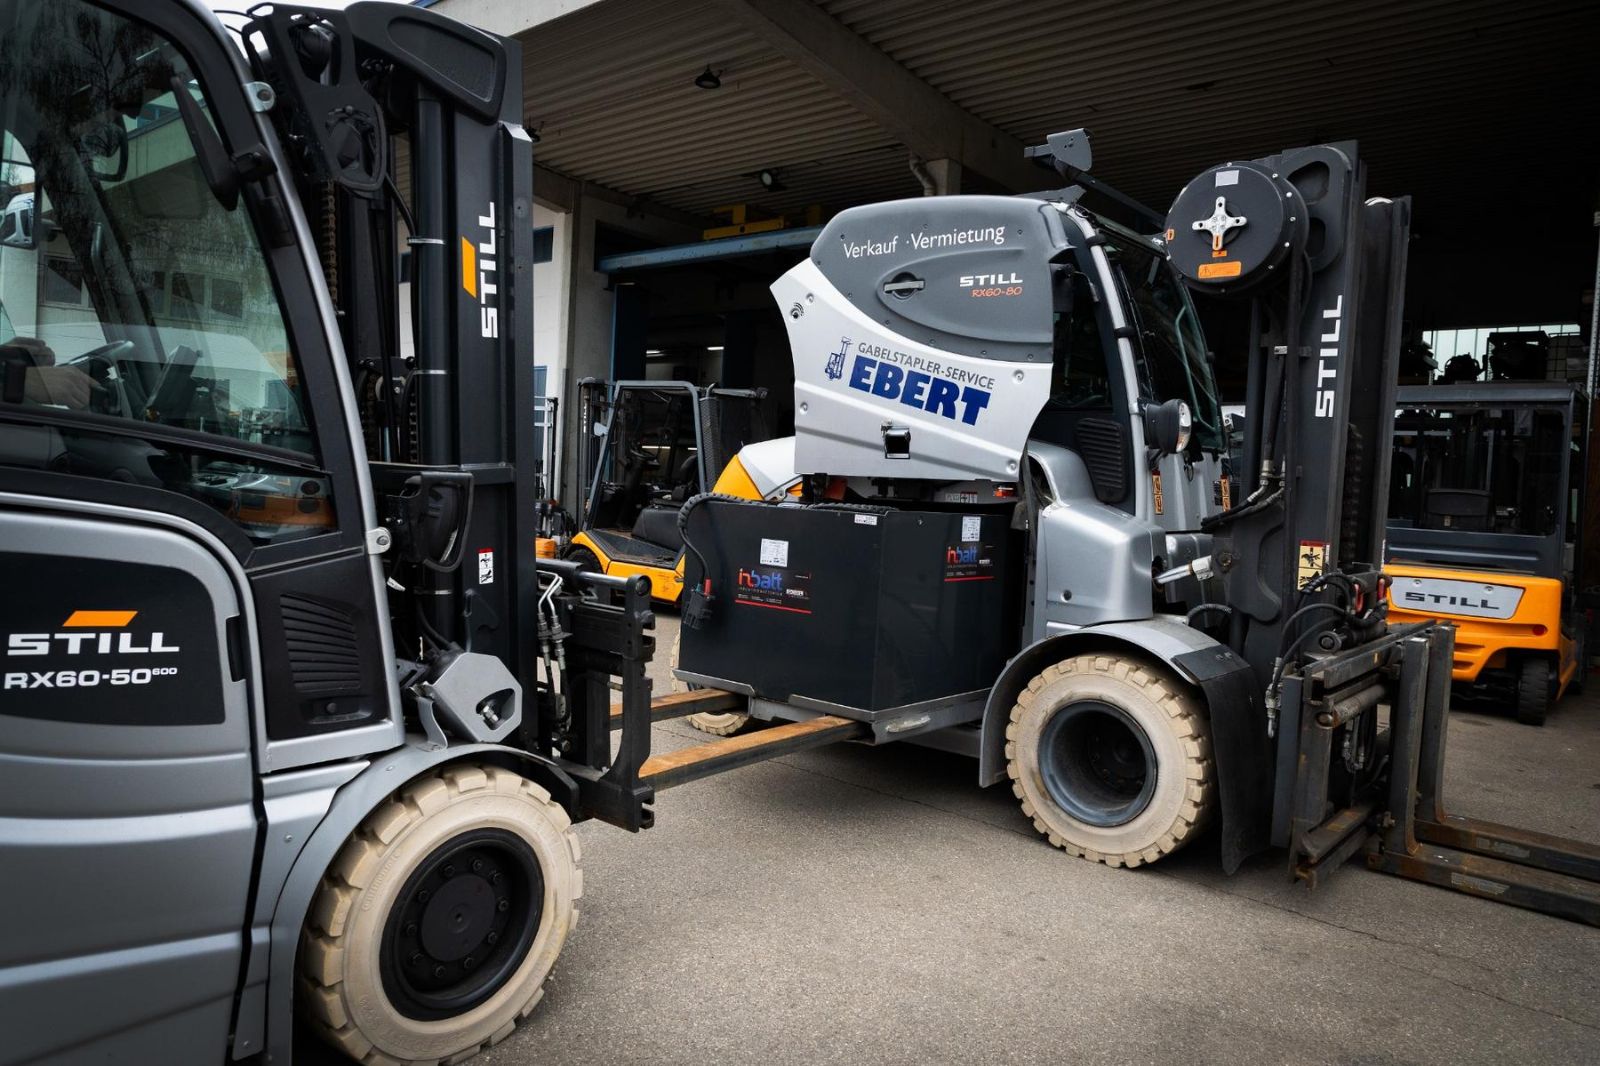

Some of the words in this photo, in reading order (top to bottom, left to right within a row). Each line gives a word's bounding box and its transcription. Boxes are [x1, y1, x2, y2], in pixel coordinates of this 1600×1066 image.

[844, 236, 899, 258] Verkauf
[911, 226, 1005, 249] Vermietung
[479, 202, 498, 338] STILL
[960, 272, 1023, 287] STILL
[971, 286, 1023, 298] RX60-80
[858, 342, 995, 389] GABELSTAPLER-SERVICE
[1315, 295, 1342, 417] STILL
[849, 355, 991, 426] EBERT
[1405, 592, 1500, 610] STILL
[8, 632, 180, 655] STILL
